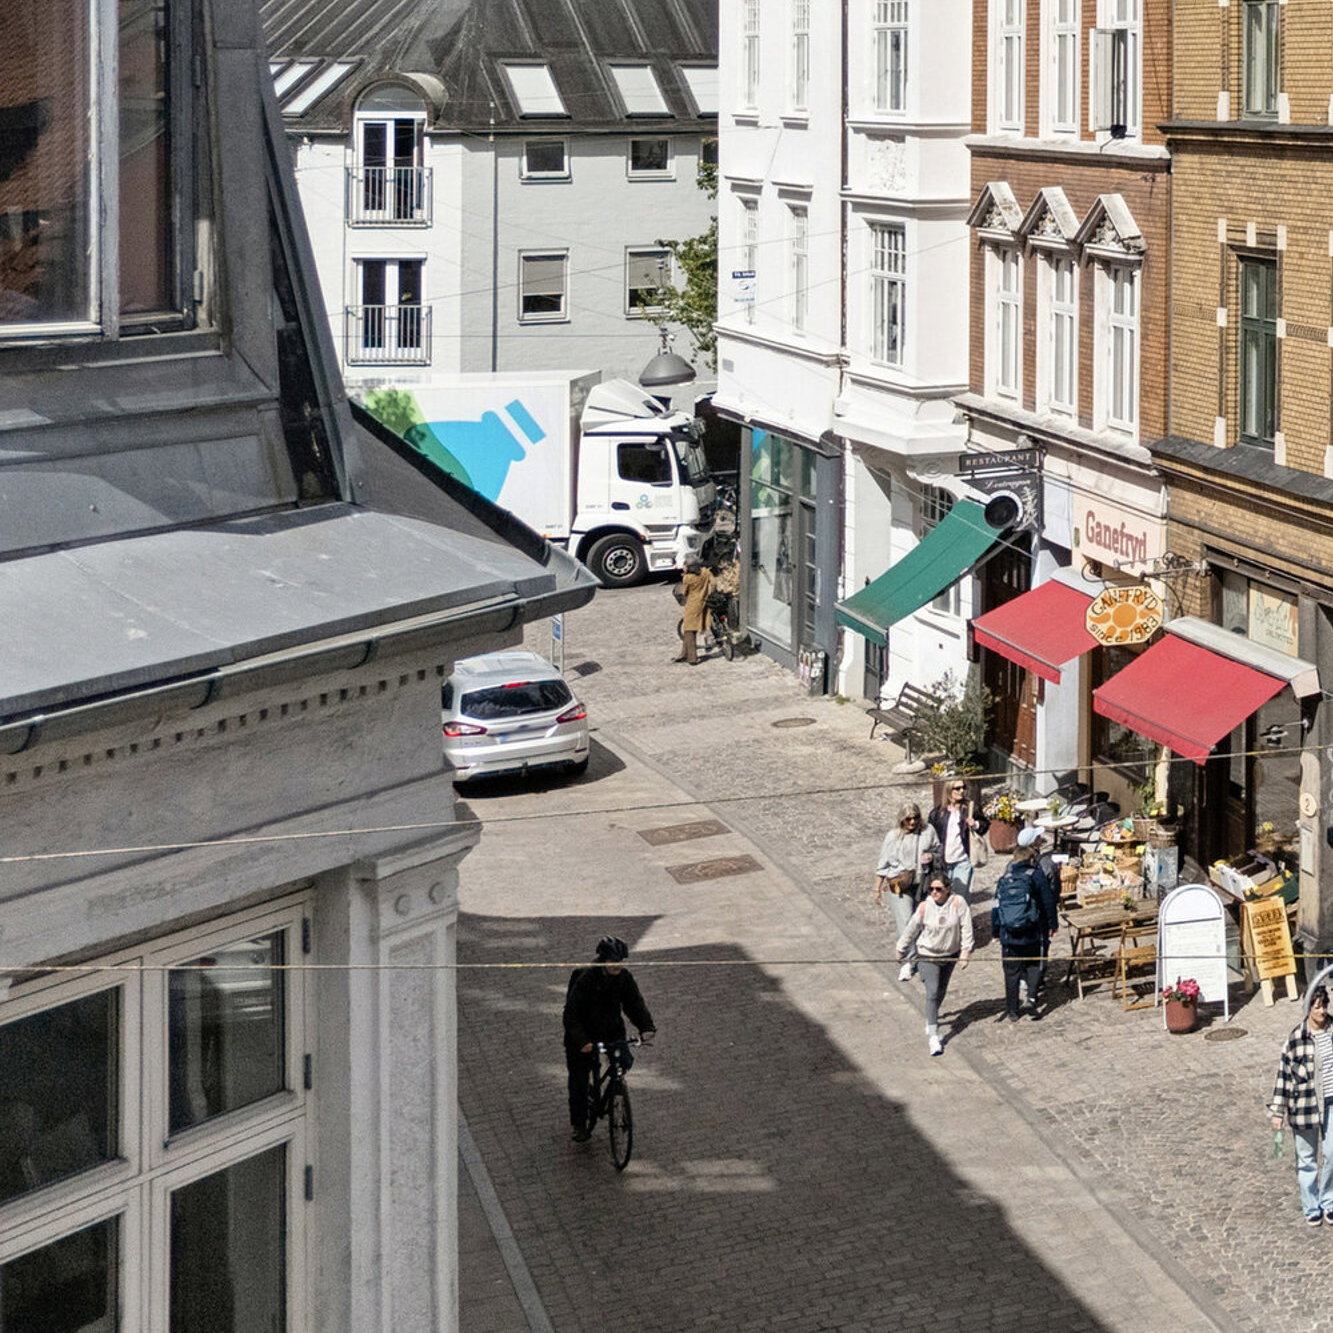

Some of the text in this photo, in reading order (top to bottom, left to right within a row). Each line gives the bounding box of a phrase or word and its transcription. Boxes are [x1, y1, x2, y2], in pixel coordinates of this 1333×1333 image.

[965, 453, 1031, 466] RESTAURANT
[1086, 510, 1148, 568] Ganefryd
[1090, 588, 1159, 616] GANEFRYD
[1089, 616, 1159, 643] since 1983
